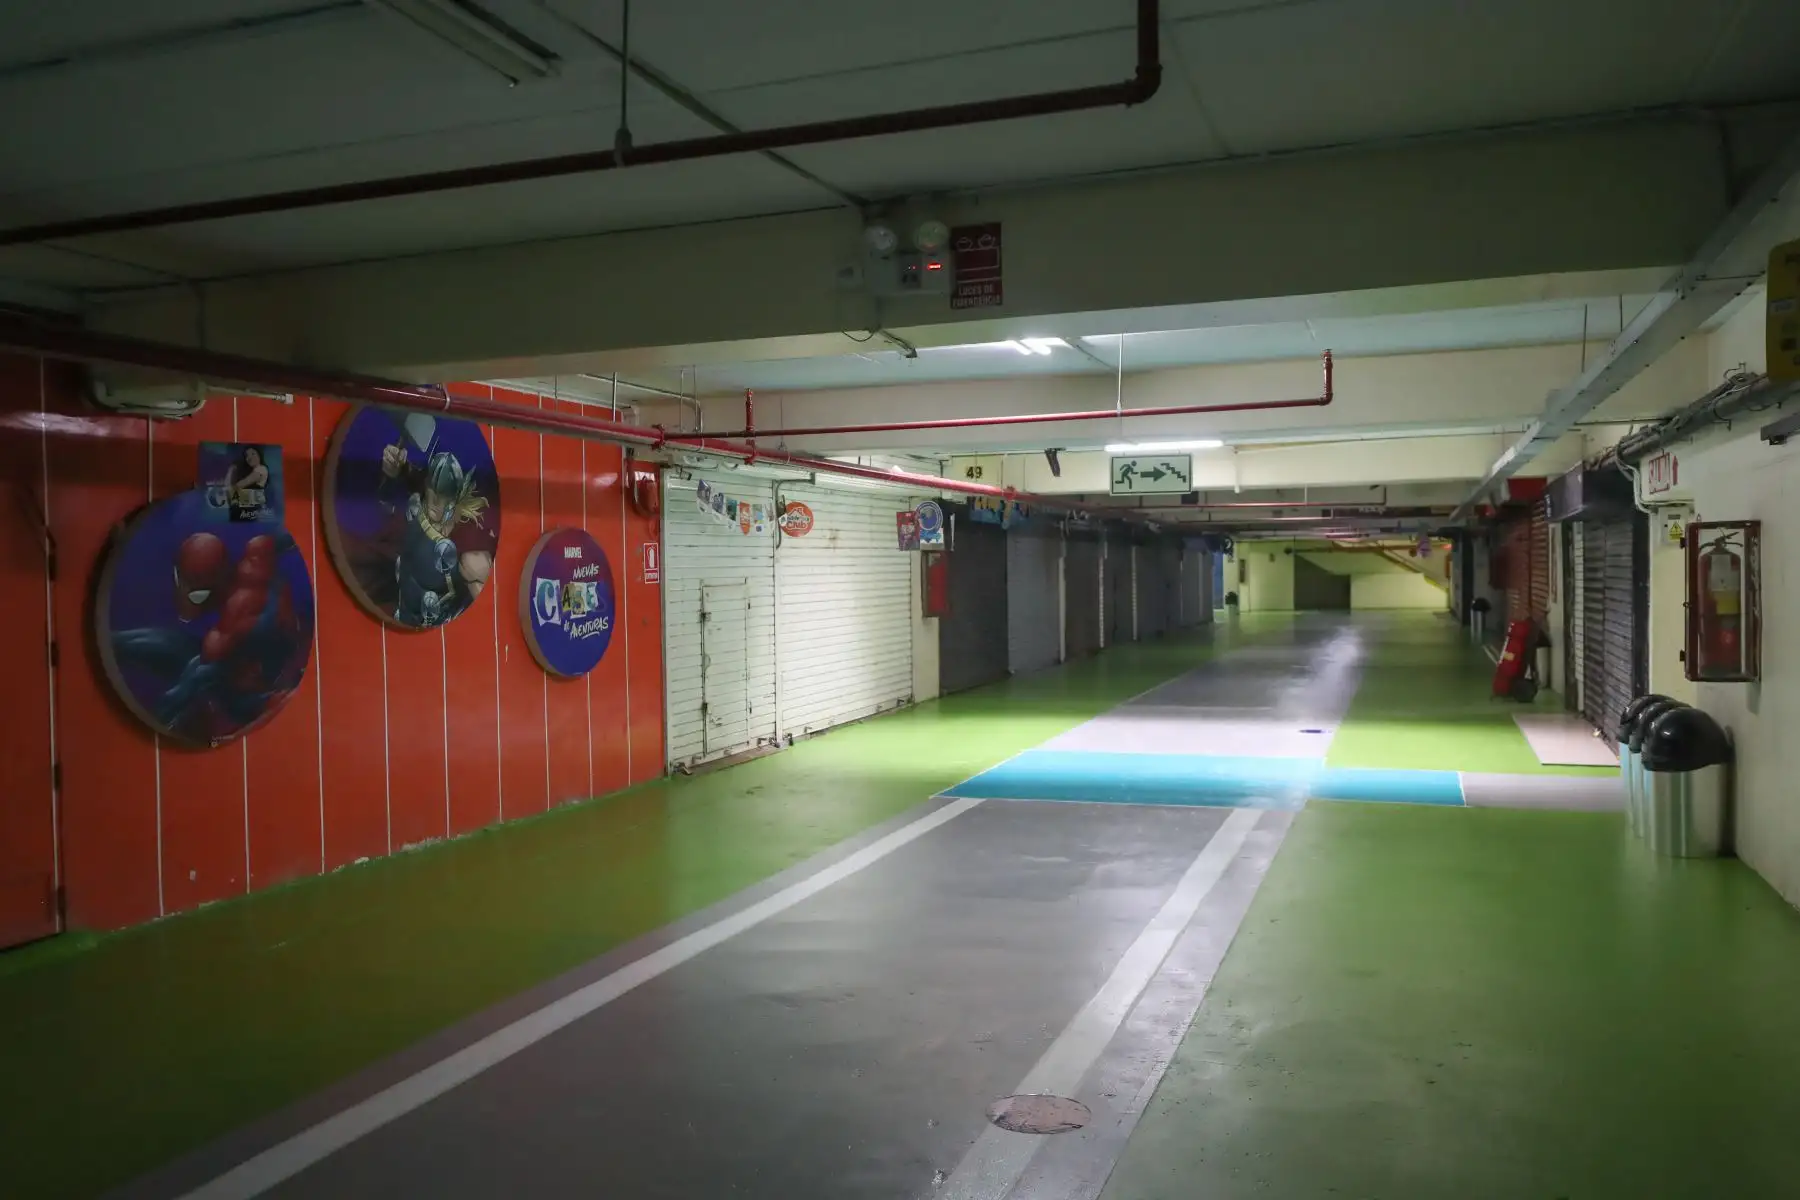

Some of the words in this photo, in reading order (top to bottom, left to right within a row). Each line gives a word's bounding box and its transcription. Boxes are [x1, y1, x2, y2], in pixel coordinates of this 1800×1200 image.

[966, 466, 983, 479] 49
[564, 546, 582, 559] MARVEL
[572, 563, 600, 580] NUEVAS
[570, 616, 609, 640] AVENTURAS
